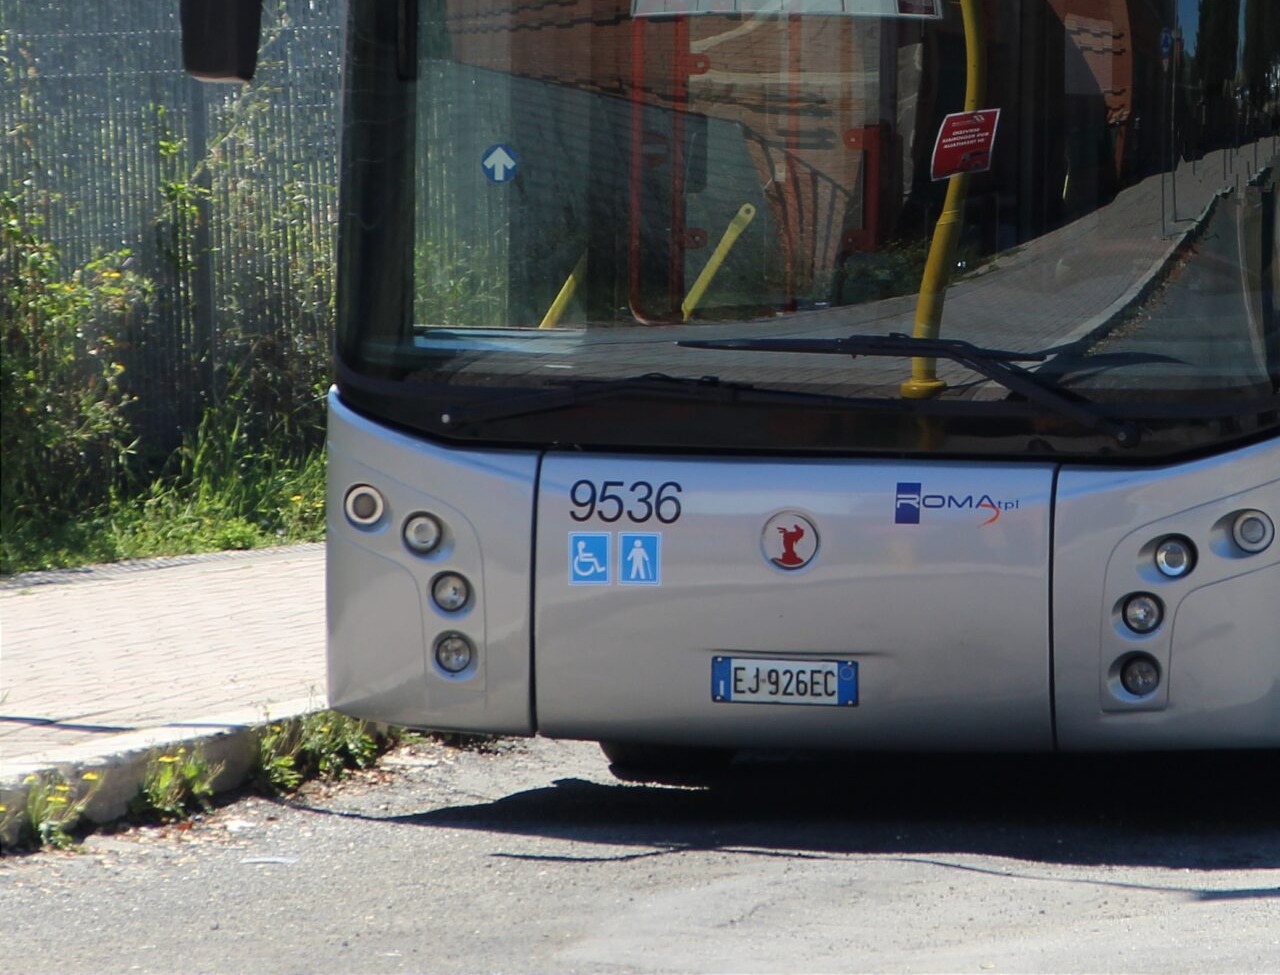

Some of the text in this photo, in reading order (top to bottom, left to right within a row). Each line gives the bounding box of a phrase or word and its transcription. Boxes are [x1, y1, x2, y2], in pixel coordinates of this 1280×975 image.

[568, 479, 683, 525] 9536
[896, 493, 1020, 512] ROMA tpl
